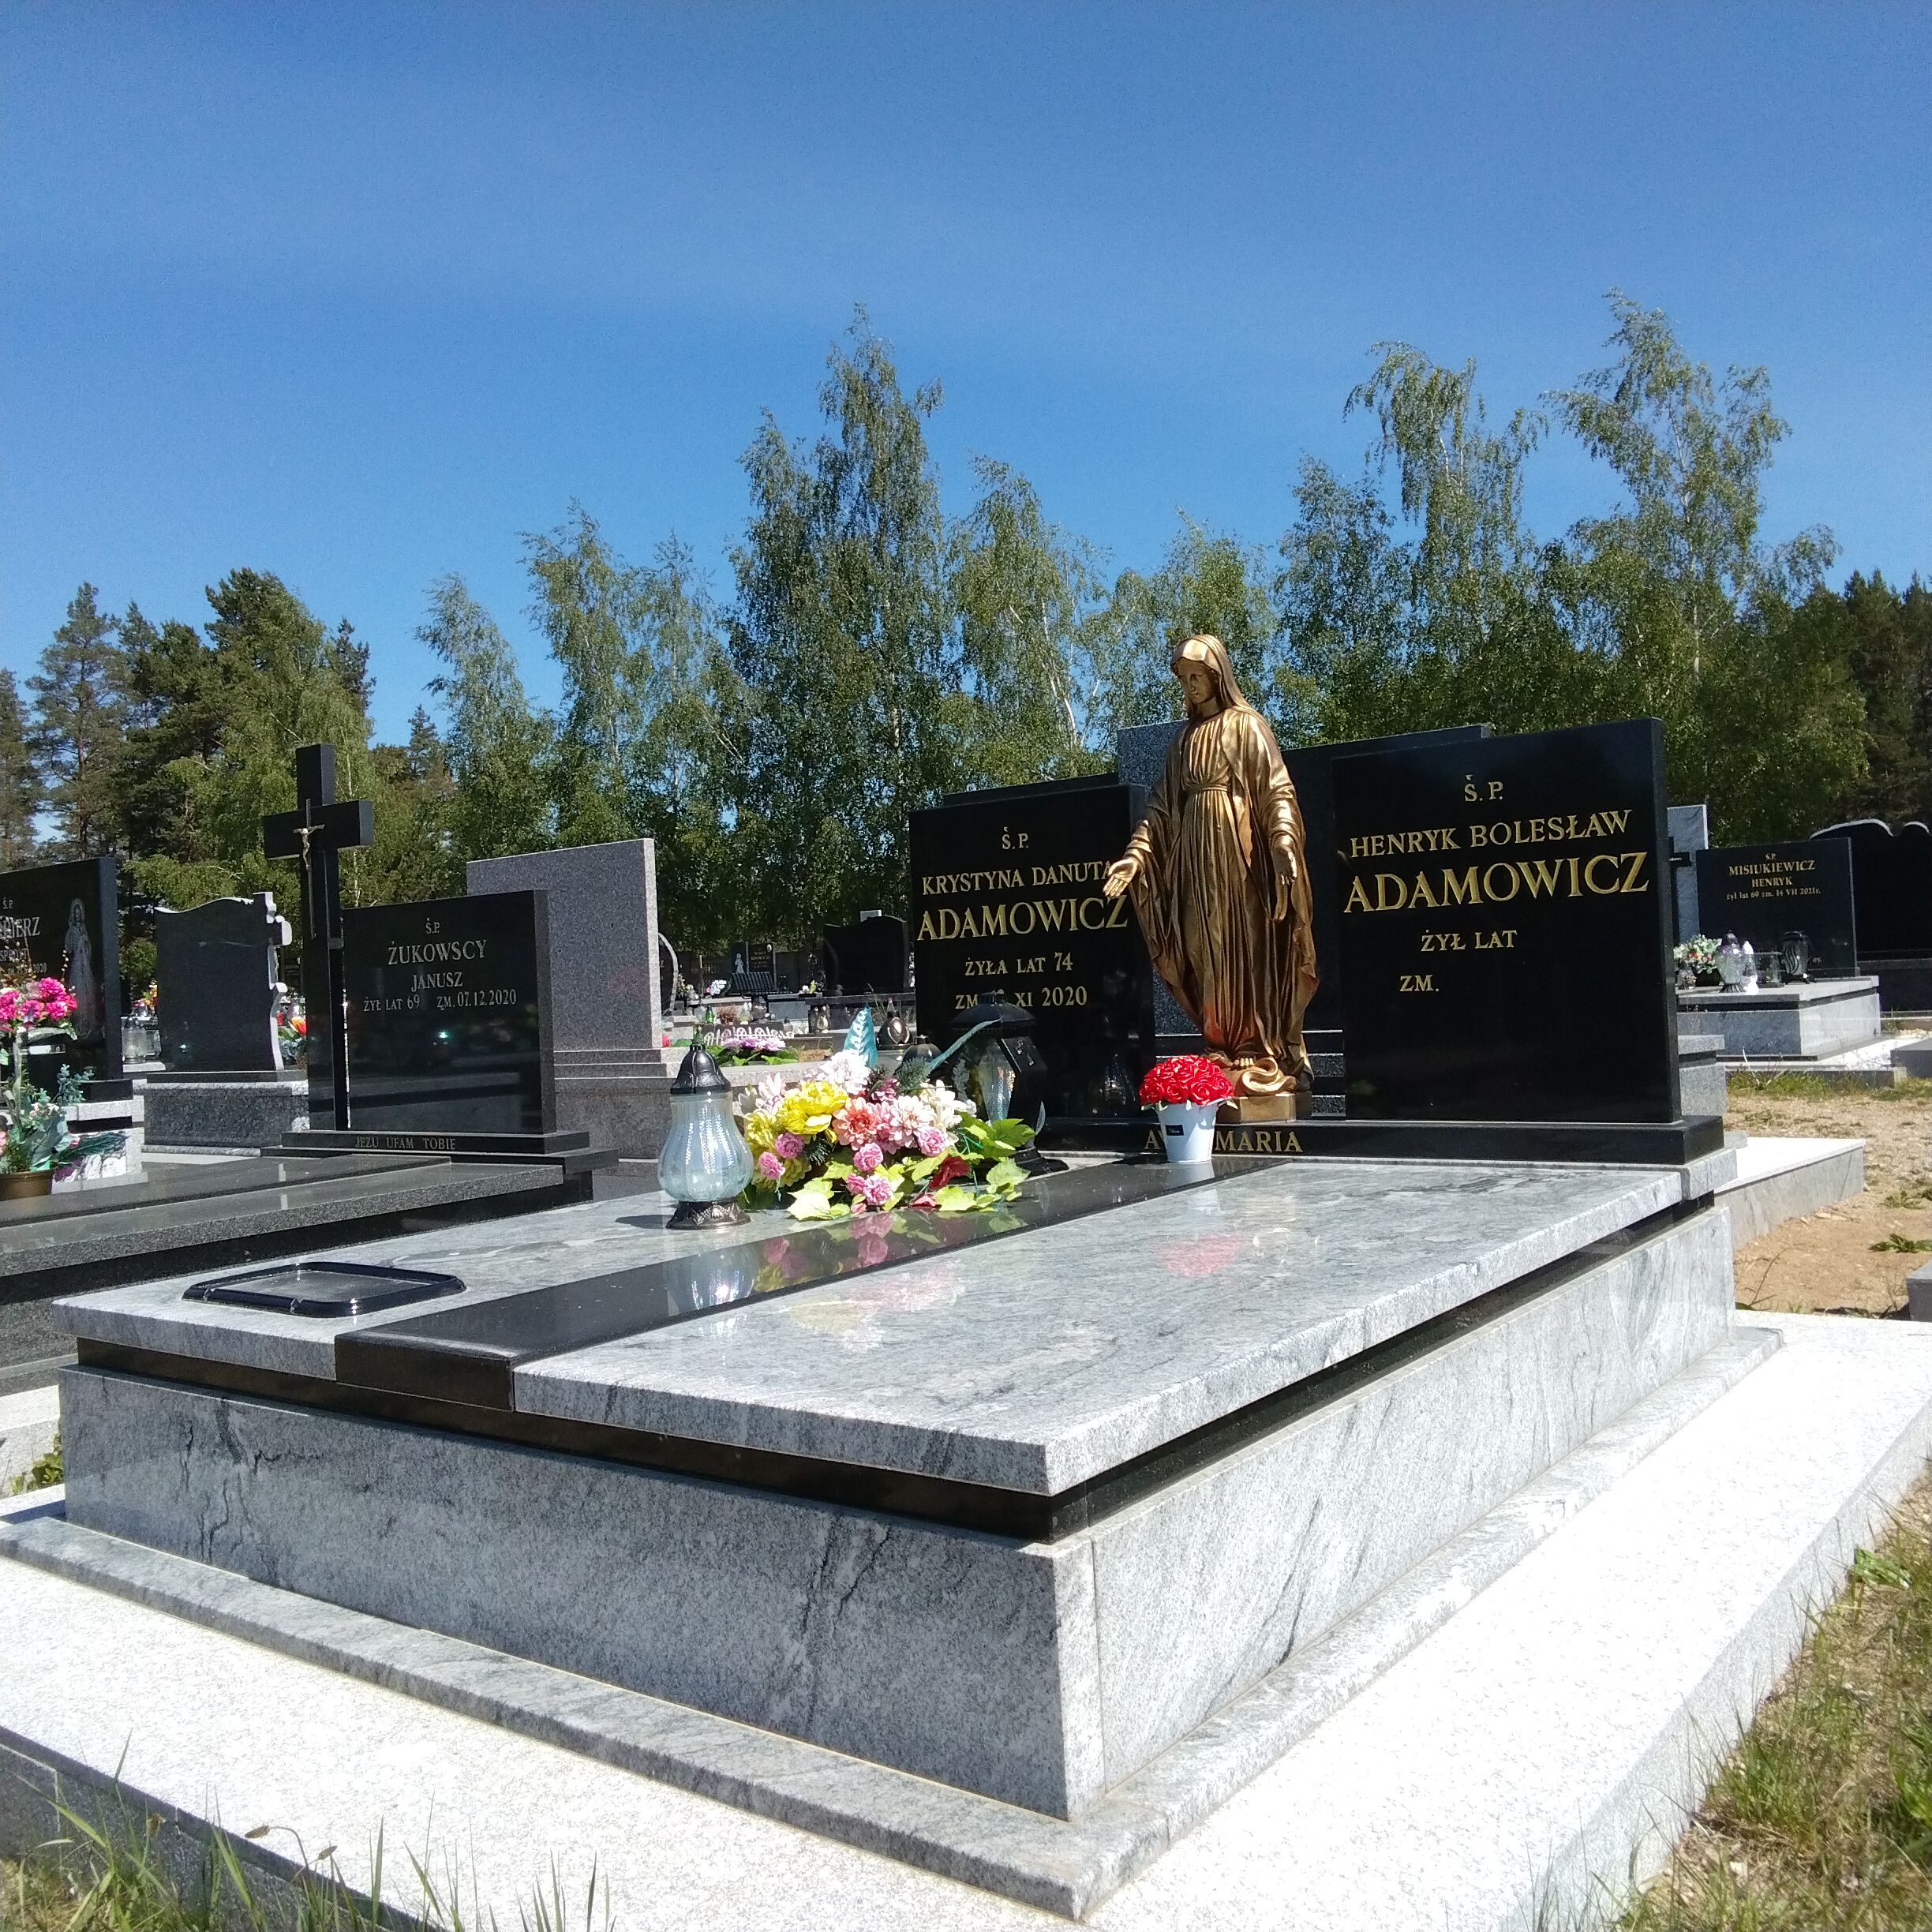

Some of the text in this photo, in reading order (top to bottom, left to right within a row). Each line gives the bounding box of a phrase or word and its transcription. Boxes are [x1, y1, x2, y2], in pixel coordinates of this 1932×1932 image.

[1350, 809, 1634, 858] HENRYK BOLESŁAW
[1728, 859, 1816, 876] MISIUKIEWICZ
[922, 871, 1025, 896] KRYSTYNA
[1343, 851, 1651, 914] ADAMOWICZ
[1751, 876, 1793, 888] HENRYK
[916, 894, 1129, 941] ADAMOWICZ
[1421, 930, 1518, 952] ŻYŁ LAT
[388, 940, 488, 965] ŻUKOWSCY
[964, 952, 1074, 976] ŻYŁA LAT 74
[411, 972, 463, 993] JANUSZ
[1399, 974, 1440, 993] ZM.
[363, 996, 382, 1013] ŻYŁ
[386, 998, 403, 1011] LAT
[406, 994, 421, 1010] 69
[1014, 991, 1034, 1008] XI
[1041, 986, 1088, 1007] 2020
[354, 1136, 457, 1151] JEZU UFAM TOBIE
[1215, 1130, 1304, 1153] MARIA
